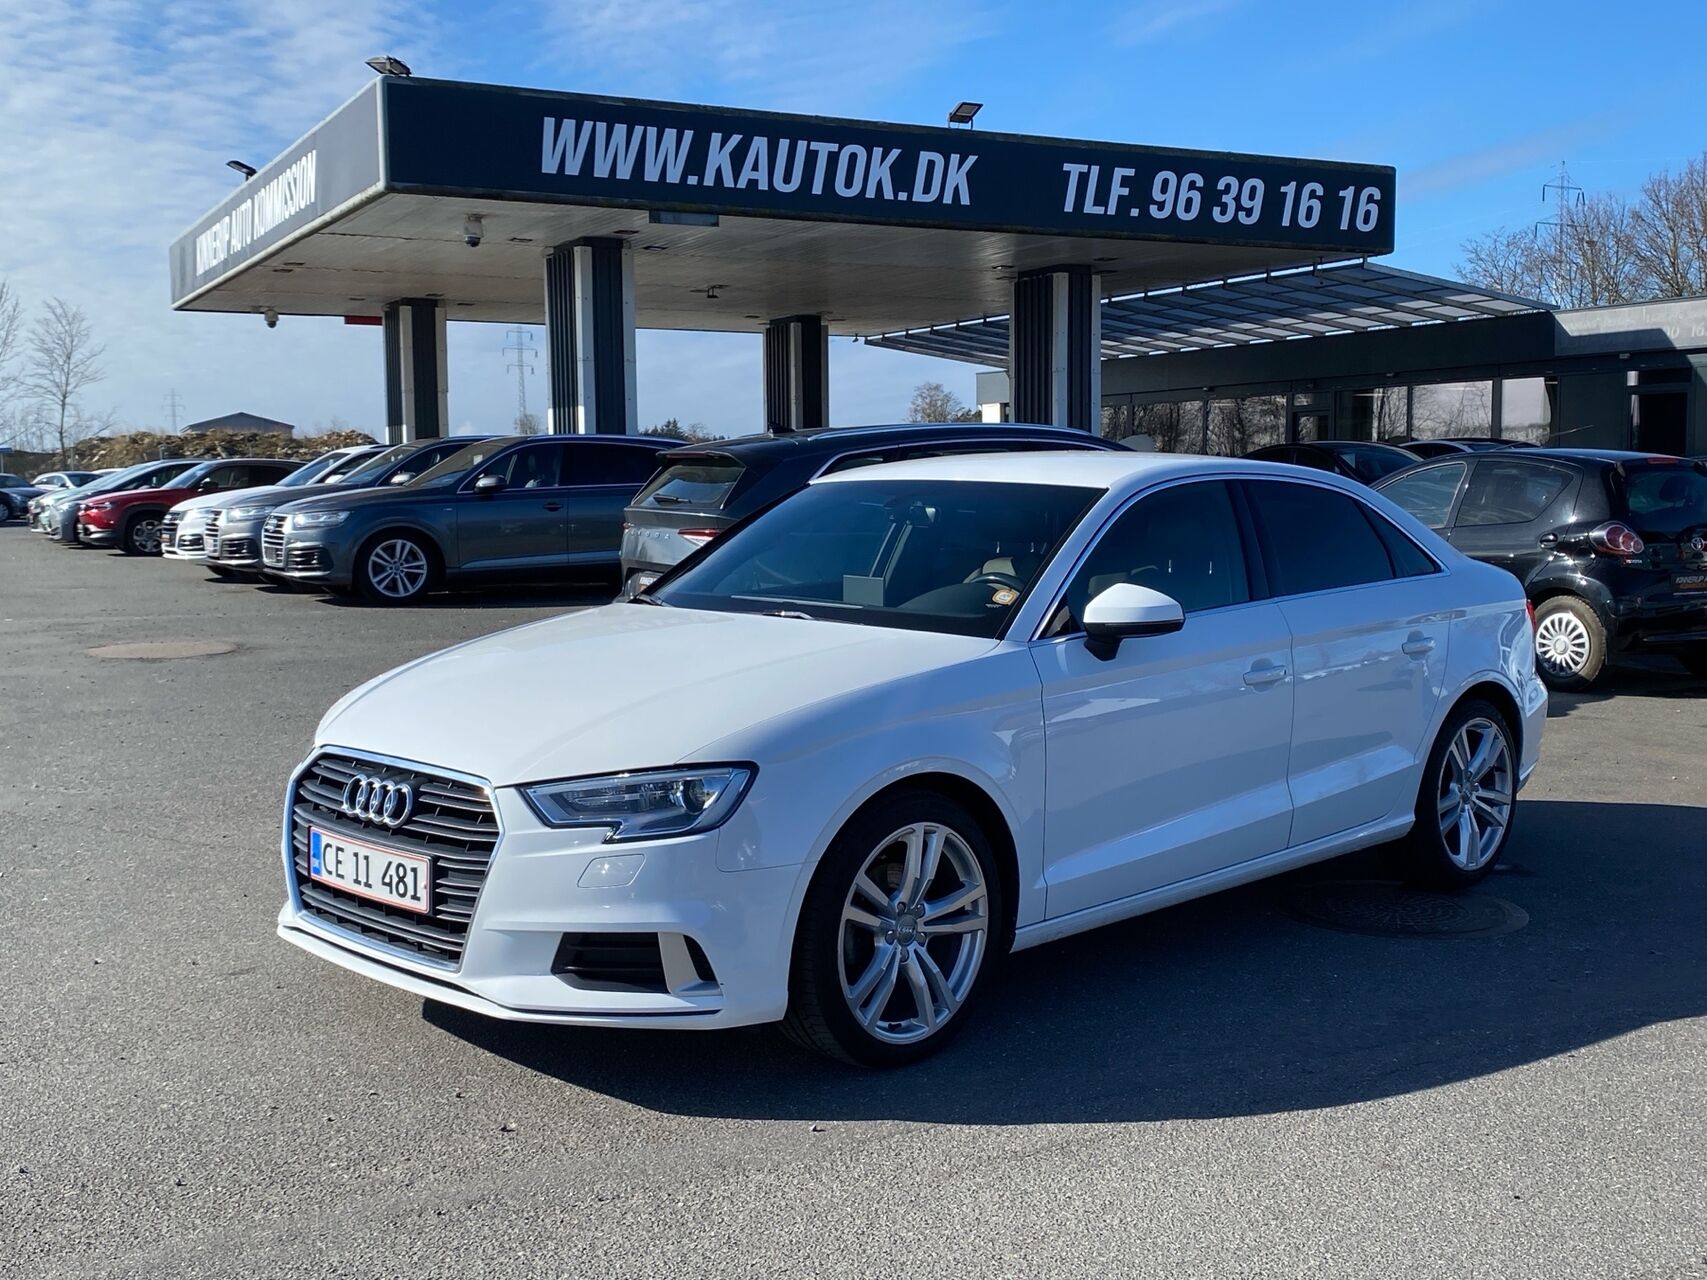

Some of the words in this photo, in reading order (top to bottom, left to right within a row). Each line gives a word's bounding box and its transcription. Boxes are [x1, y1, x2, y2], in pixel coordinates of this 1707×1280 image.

[541, 116, 979, 206] WWW.KAUTOK.DK
[230, 198, 252, 254] AUTO
[1063, 162, 1139, 217] TLF.
[1149, 170, 1204, 221] 96
[1212, 176, 1265, 225] 39
[1280, 181, 1324, 229] 16
[1338, 185, 1382, 232] 16
[323, 843, 345, 880] CE
[353, 852, 372, 889] 11
[381, 861, 421, 902] 481
